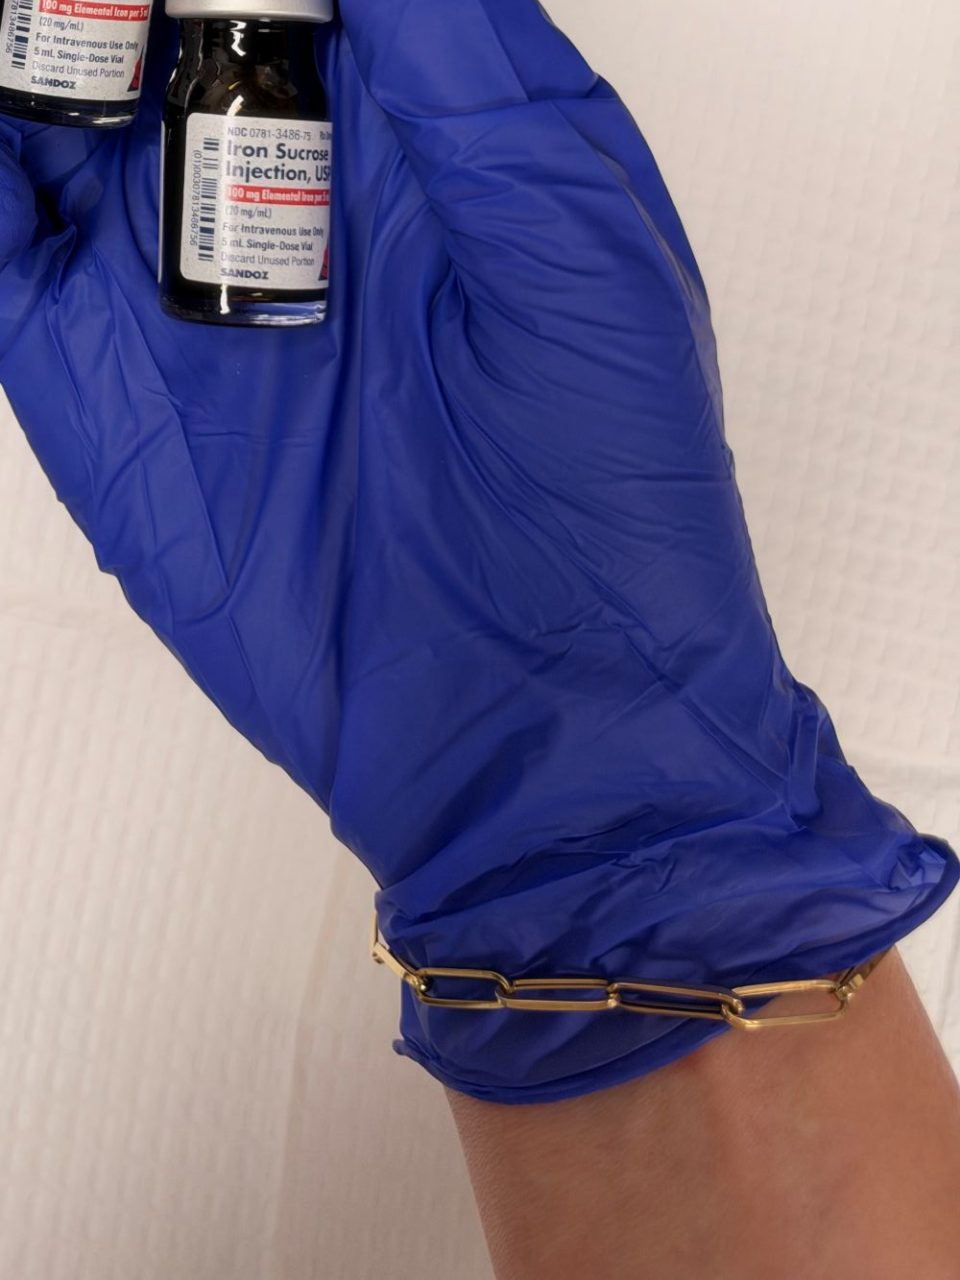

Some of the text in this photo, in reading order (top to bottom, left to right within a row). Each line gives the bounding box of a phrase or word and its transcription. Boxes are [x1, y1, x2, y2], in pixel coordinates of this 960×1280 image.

[60, 3, 72, 15] mg
[74, 3, 113, 17] Elemental
[40, 16, 52, 27] (20
[35, 32, 139, 51] For Intravenous Use Only
[33, 47, 40, 56] 5
[57, 50, 109, 63] Single-Dose
[111, 54, 124, 64] Vial
[32, 60, 125, 78] Discard Unused Portion
[31, 75, 76, 90] SANDOZ
[227, 127, 311, 141] NDC 0781-3486-75
[227, 140, 329, 161] Iron Sucrose
[226, 160, 311, 183] Injection,
[228, 187, 244, 198] 100
[246, 191, 260, 202] mg
[262, 190, 301, 202] Elemental
[222, 222, 324, 238] For Intravenous Use Only
[221, 238, 228, 246] 5
[246, 239, 300, 251] Single-Dose
[301, 242, 313, 251] Vial
[220, 252, 315, 266] Discard Unused Portion
[220, 268, 269, 280] SANDOZ
